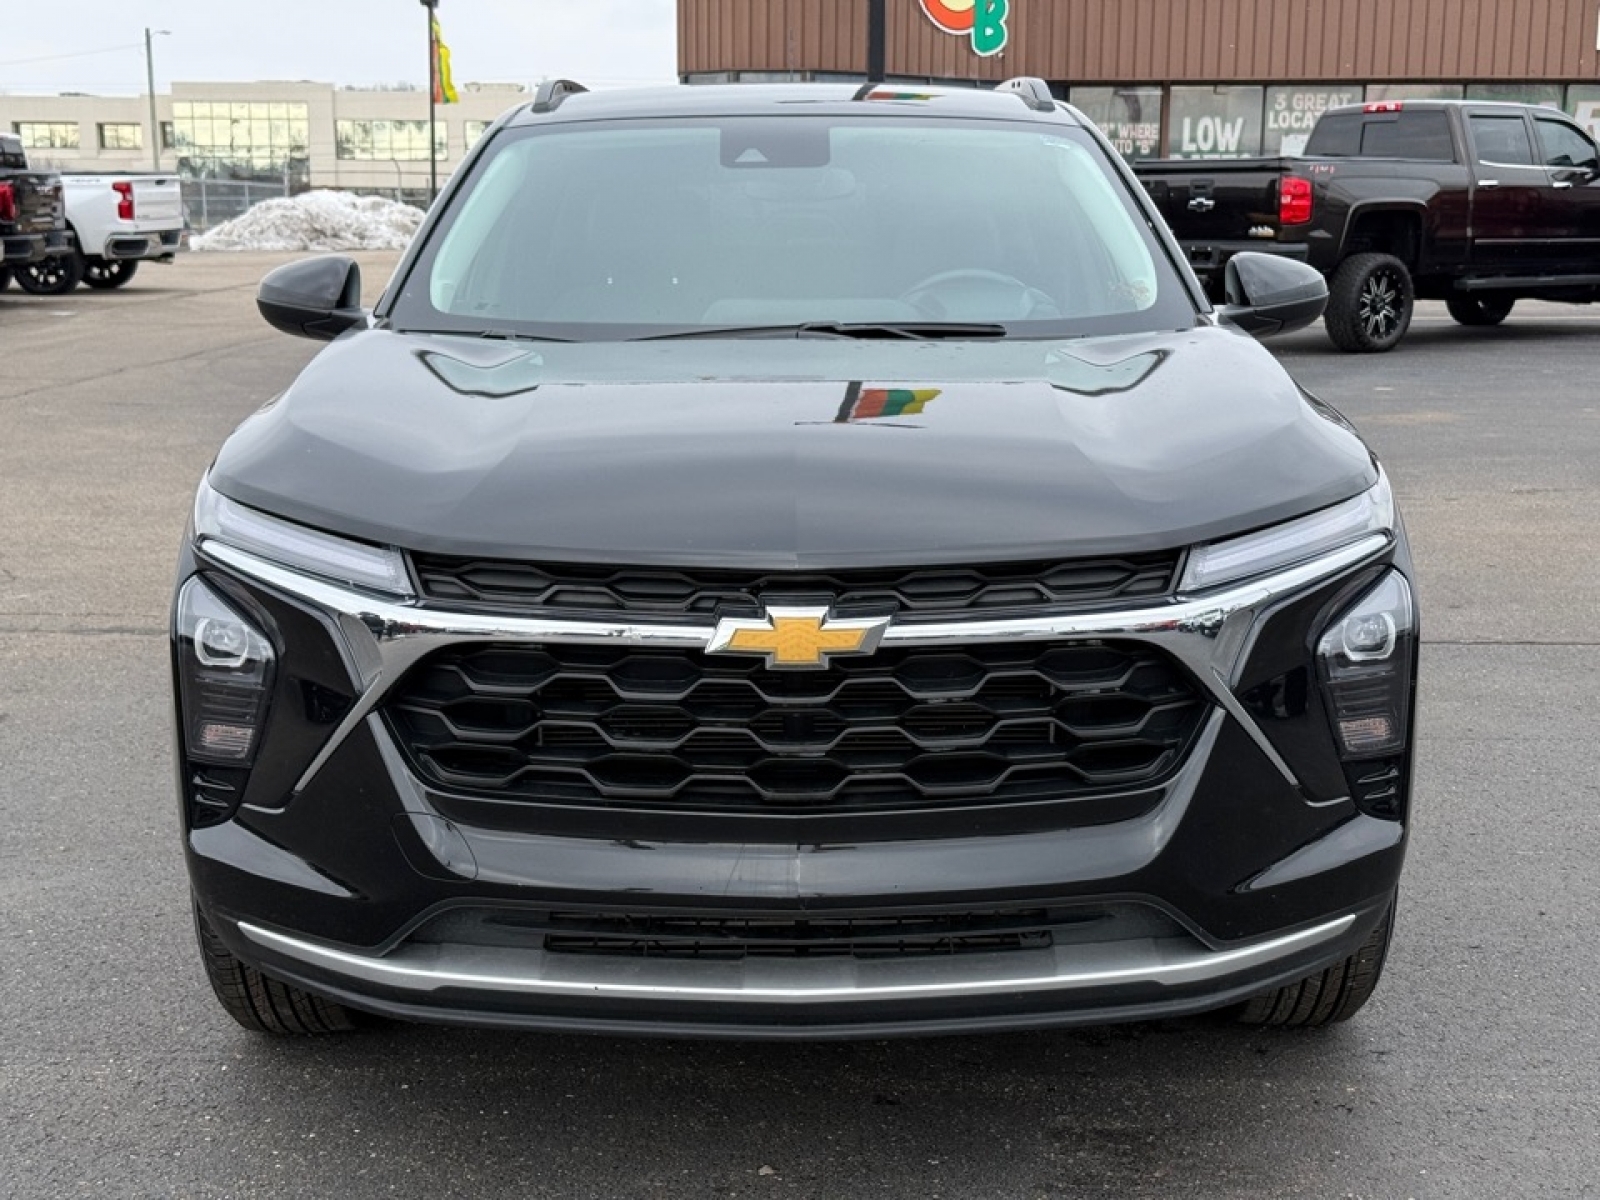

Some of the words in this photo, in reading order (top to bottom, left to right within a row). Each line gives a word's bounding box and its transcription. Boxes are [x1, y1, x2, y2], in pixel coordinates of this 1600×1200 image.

[1274, 92, 1287, 111] 3
[1292, 92, 1353, 111] GREAT
[1117, 122, 1160, 139] WHERE
[1181, 115, 1245, 153] LOW
